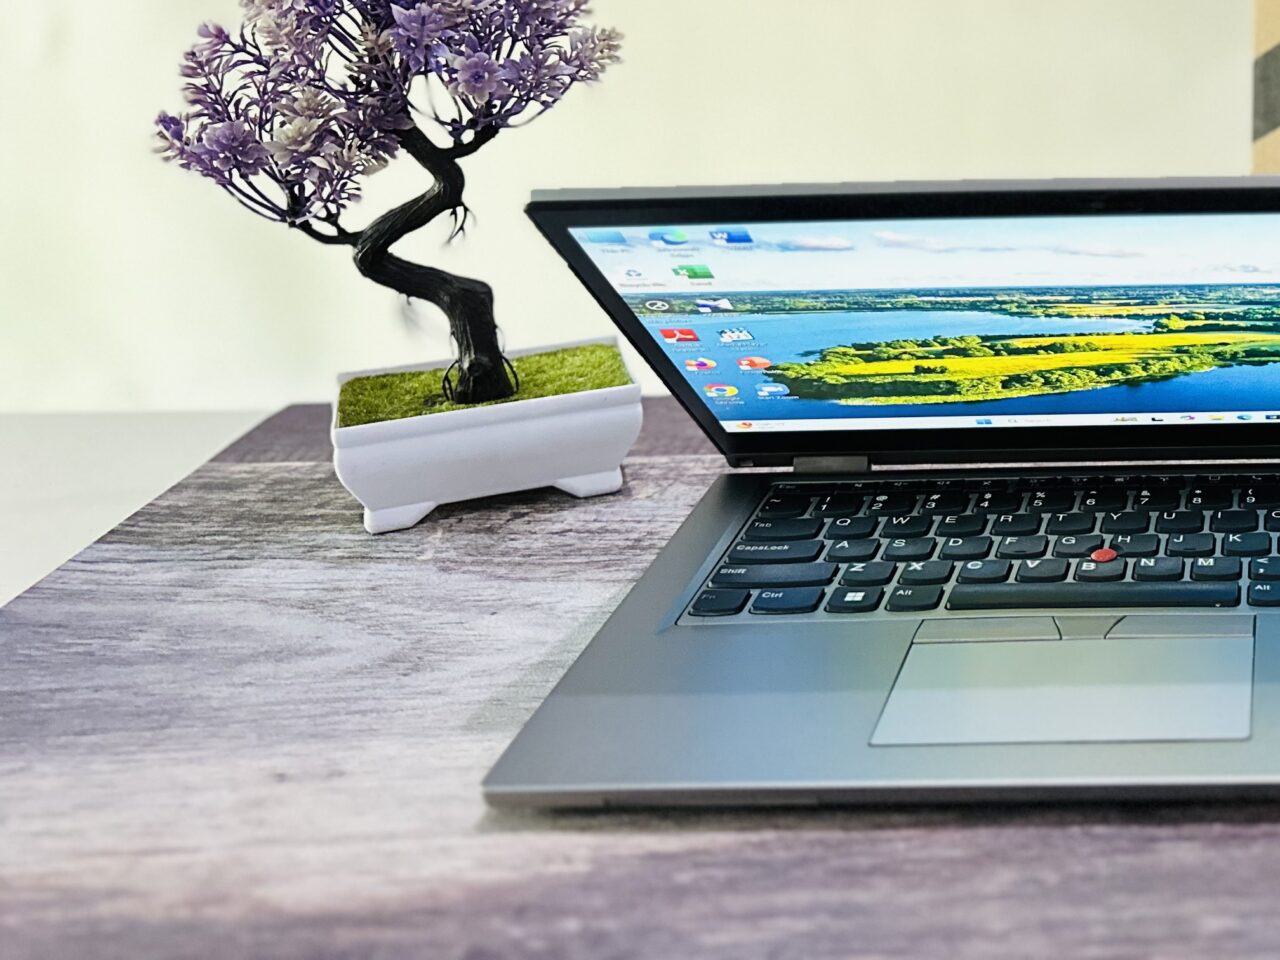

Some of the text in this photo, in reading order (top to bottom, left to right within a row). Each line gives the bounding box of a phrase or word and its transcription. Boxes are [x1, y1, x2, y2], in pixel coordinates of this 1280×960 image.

[979, 500, 989, 508] 4
[1032, 499, 1043, 507] 5
[1086, 498, 1096, 506] 6
[1246, 496, 1256, 504] 9
[871, 502, 883, 510] 2
[925, 501, 936, 509] 3
[892, 516, 911, 525] W
[944, 515, 958, 524] E
[1000, 514, 1013, 523] R
[1056, 513, 1068, 522] T
[1110, 512, 1122, 521] Y
[1163, 512, 1177, 520] U
[835, 518, 851, 526] Q
[948, 538, 963, 547] D
[1004, 536, 1019, 545] F
[1061, 536, 1076, 545] G
[1117, 535, 1131, 544] H
[1173, 534, 1184, 543] J
[1228, 533, 1242, 543] K
[735, 543, 790, 552] CapsLock
[835, 540, 849, 549] A
[892, 539, 906, 548] S
[907, 561, 926, 571] X
[966, 560, 983, 570] C
[1026, 559, 1042, 569] V
[1081, 561, 1097, 571] B
[1140, 558, 1156, 567] N
[1197, 557, 1215, 566] M
[718, 567, 748, 575] Shift
[849, 563, 867, 572] Z
[761, 590, 783, 598] Ctrl
